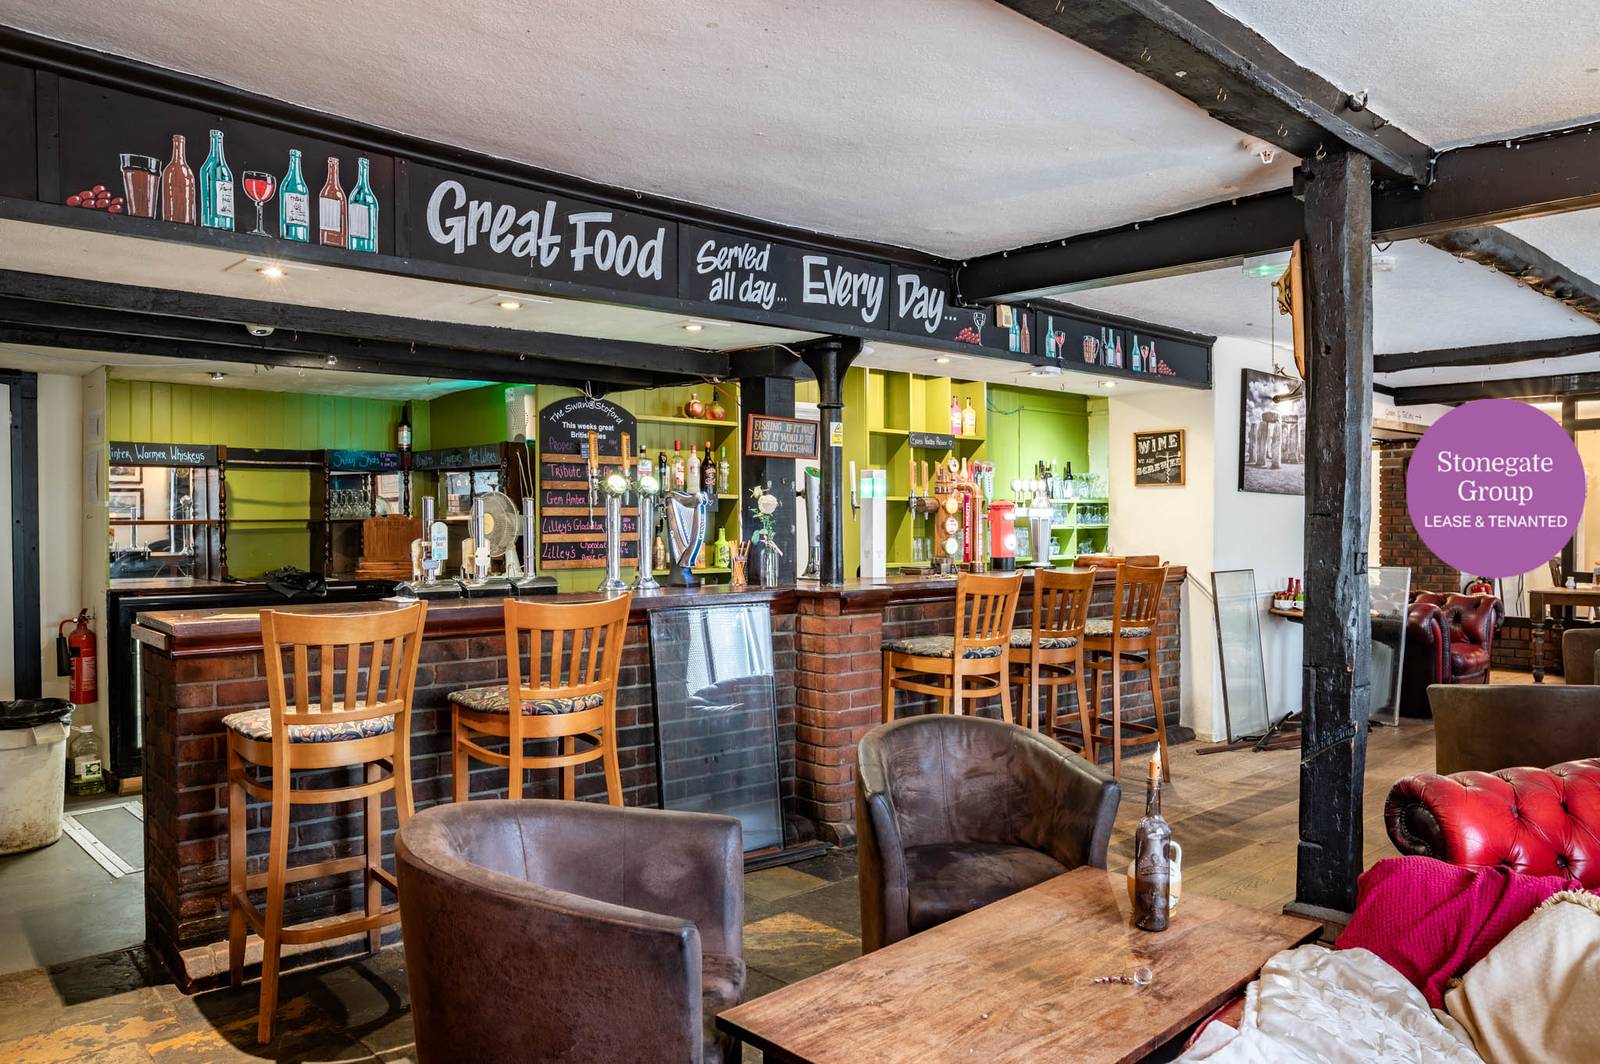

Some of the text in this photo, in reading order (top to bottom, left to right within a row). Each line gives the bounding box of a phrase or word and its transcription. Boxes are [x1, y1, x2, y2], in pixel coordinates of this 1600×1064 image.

[427, 180, 665, 280] Great Food
[697, 239, 770, 273] Served
[709, 272, 735, 302] all
[803, 255, 883, 323] Every
[550, 409, 565, 423] The
[562, 421, 615, 432] This weeks great
[571, 431, 590, 439] Britis
[754, 430, 772, 441] EASY
[753, 441, 779, 452] CALLED
[1138, 434, 1178, 454] WINE
[109, 445, 133, 462] inter
[170, 445, 205, 463] Whiskeys
[547, 464, 581, 478] Tribute
[546, 491, 563, 505] Gem
[543, 518, 572, 534] Lilley's
[543, 543, 576, 559] Lilley's
